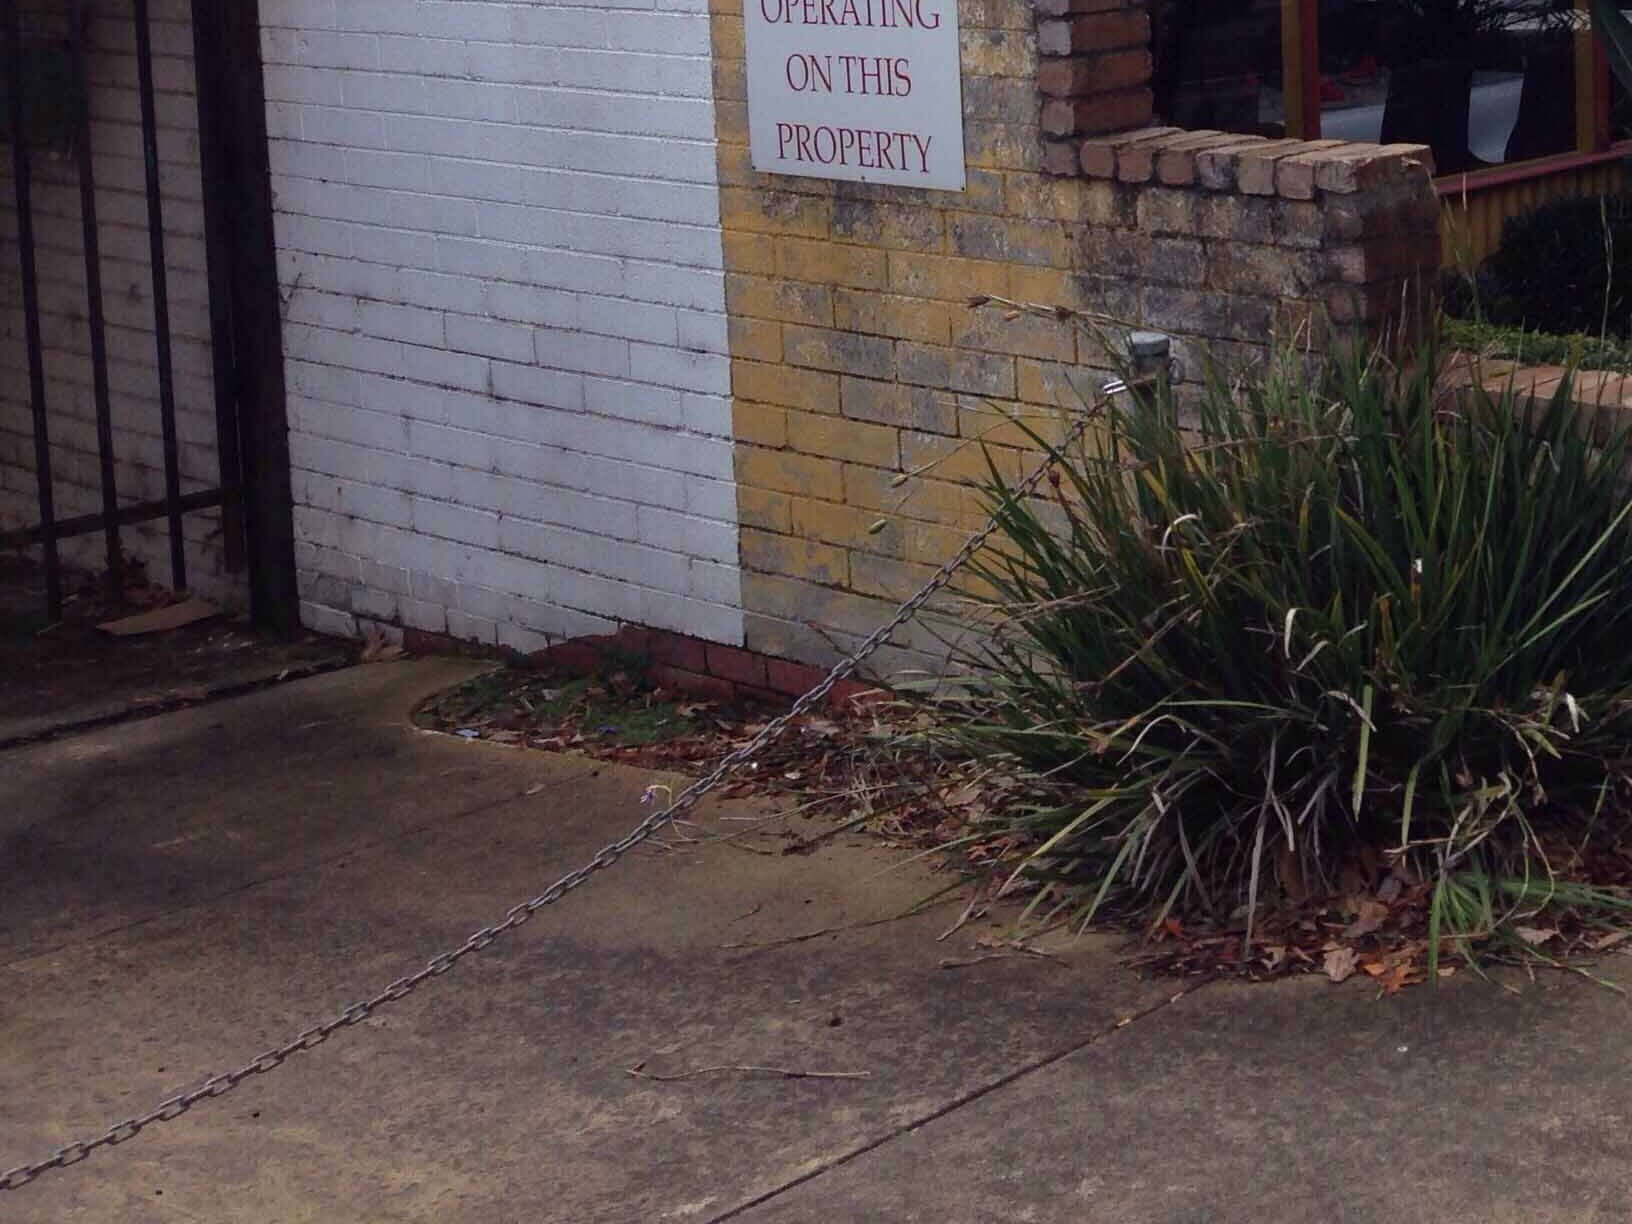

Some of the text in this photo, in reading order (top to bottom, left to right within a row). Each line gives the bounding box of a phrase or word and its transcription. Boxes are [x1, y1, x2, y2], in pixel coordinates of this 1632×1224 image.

[786, 53, 912, 97] ON THIS
[776, 122, 931, 173] PROPERTY
